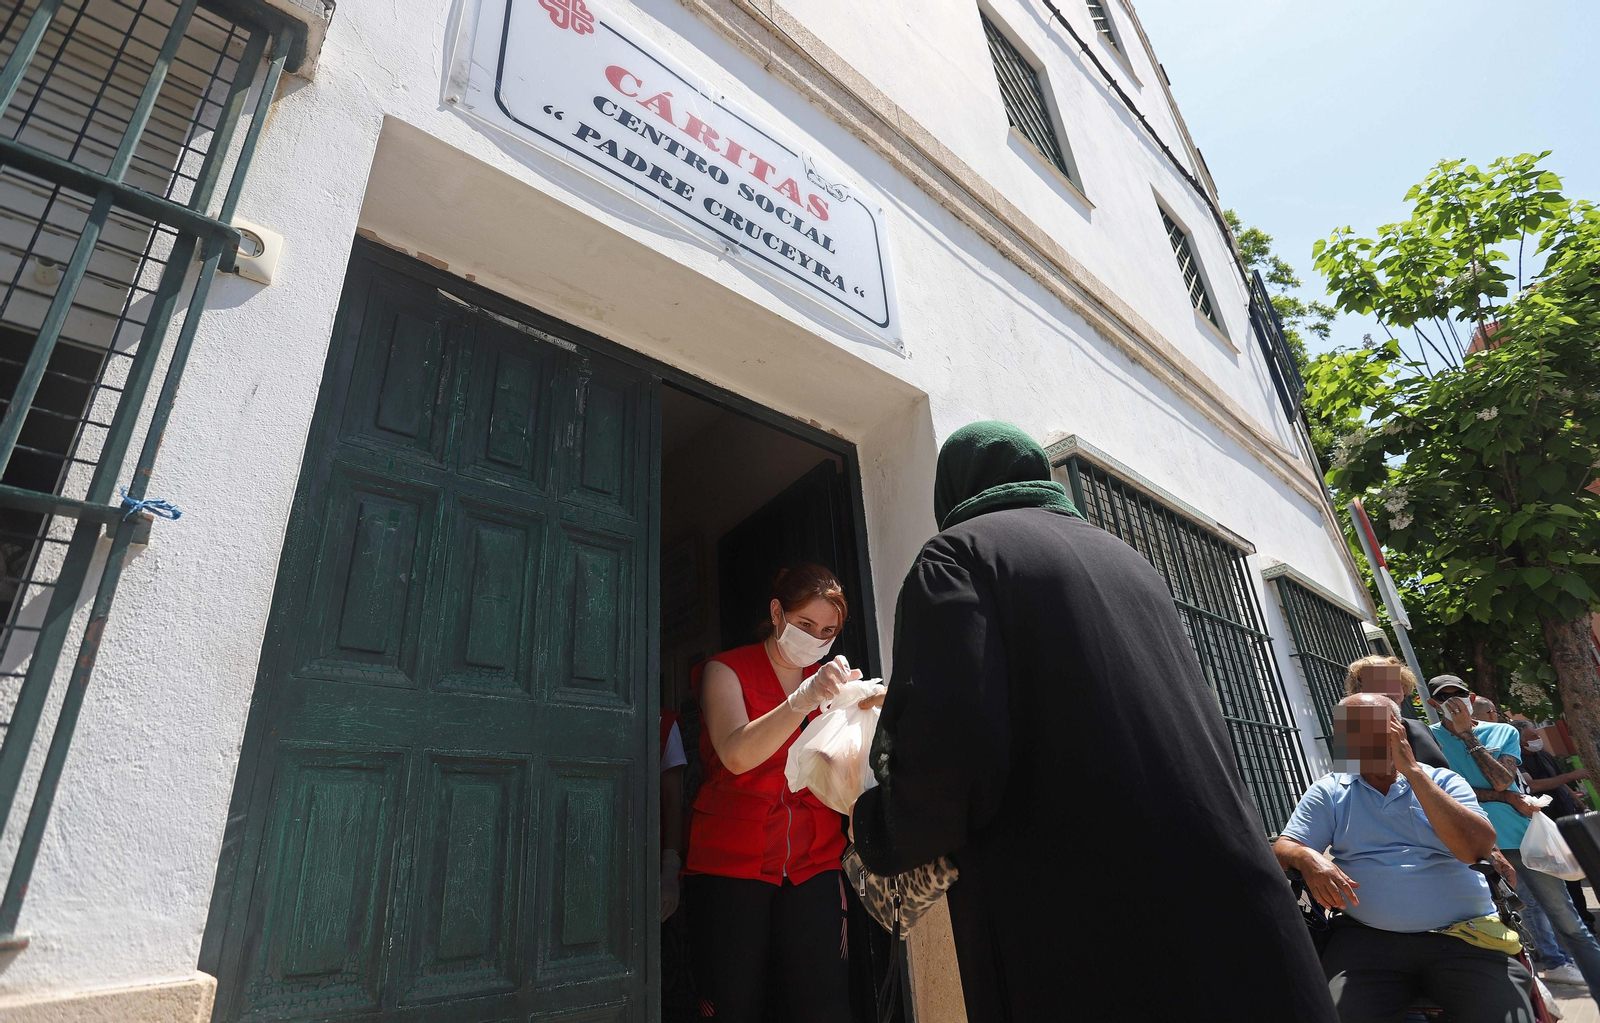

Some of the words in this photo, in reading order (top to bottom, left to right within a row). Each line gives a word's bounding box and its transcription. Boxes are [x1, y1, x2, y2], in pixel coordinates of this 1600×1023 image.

[572, 121, 695, 202] PADRE
[703, 197, 847, 293] CRUCEYRA
[593, 96, 729, 185] CENTRO
[738, 183, 835, 254] SOCIAL
[605, 65, 829, 221] CÁRITAS
